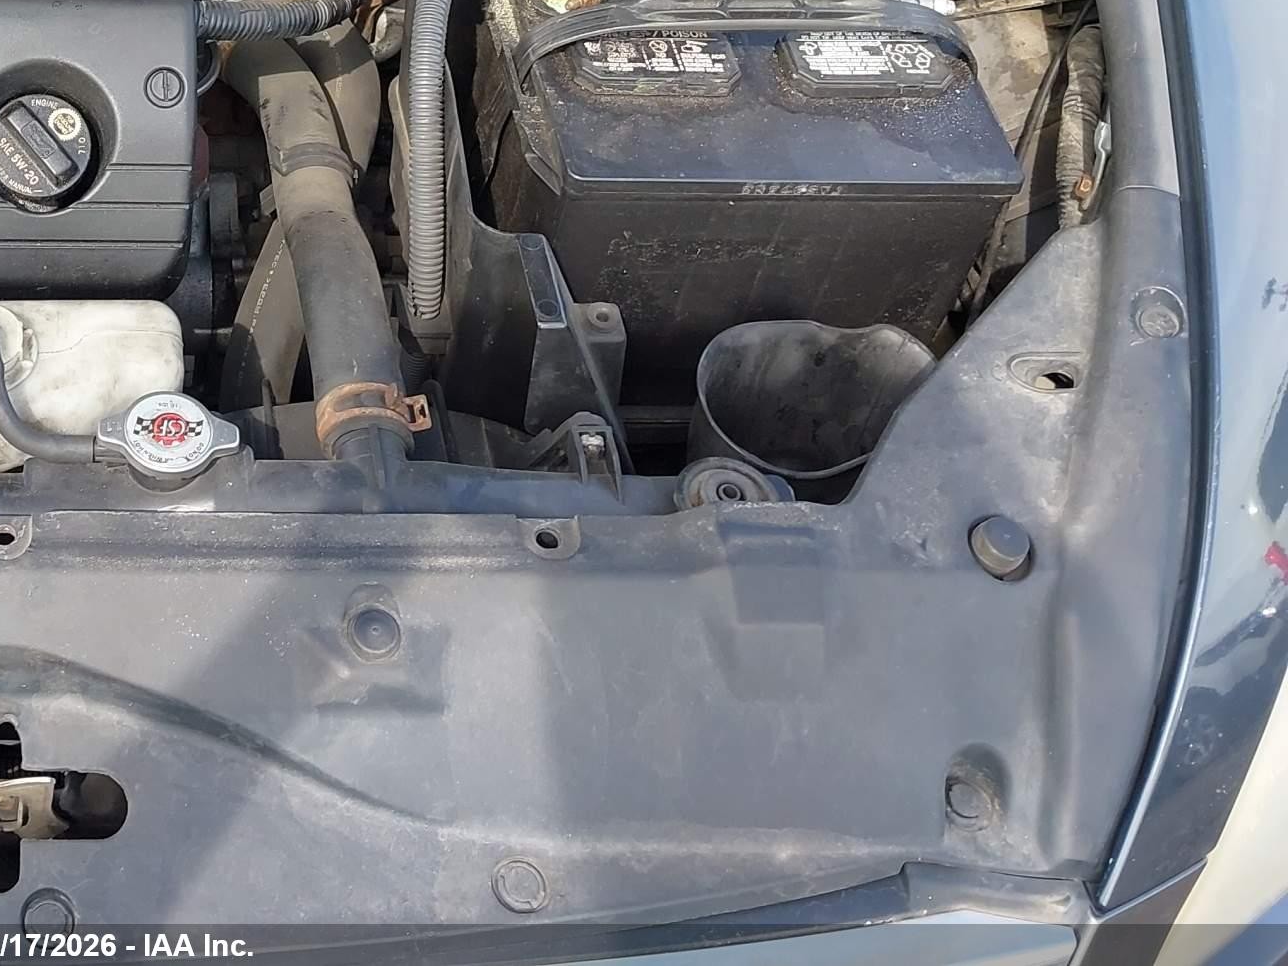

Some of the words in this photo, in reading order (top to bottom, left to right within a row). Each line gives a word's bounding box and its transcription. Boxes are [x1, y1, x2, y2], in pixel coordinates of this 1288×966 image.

[662, 31, 708, 39] POISON
[31, 98, 60, 110] ENGINE
[78, 137, 86, 155] OIL
[8, 178, 33, 194] MANUAL
[155, 419, 185, 436] CSF
